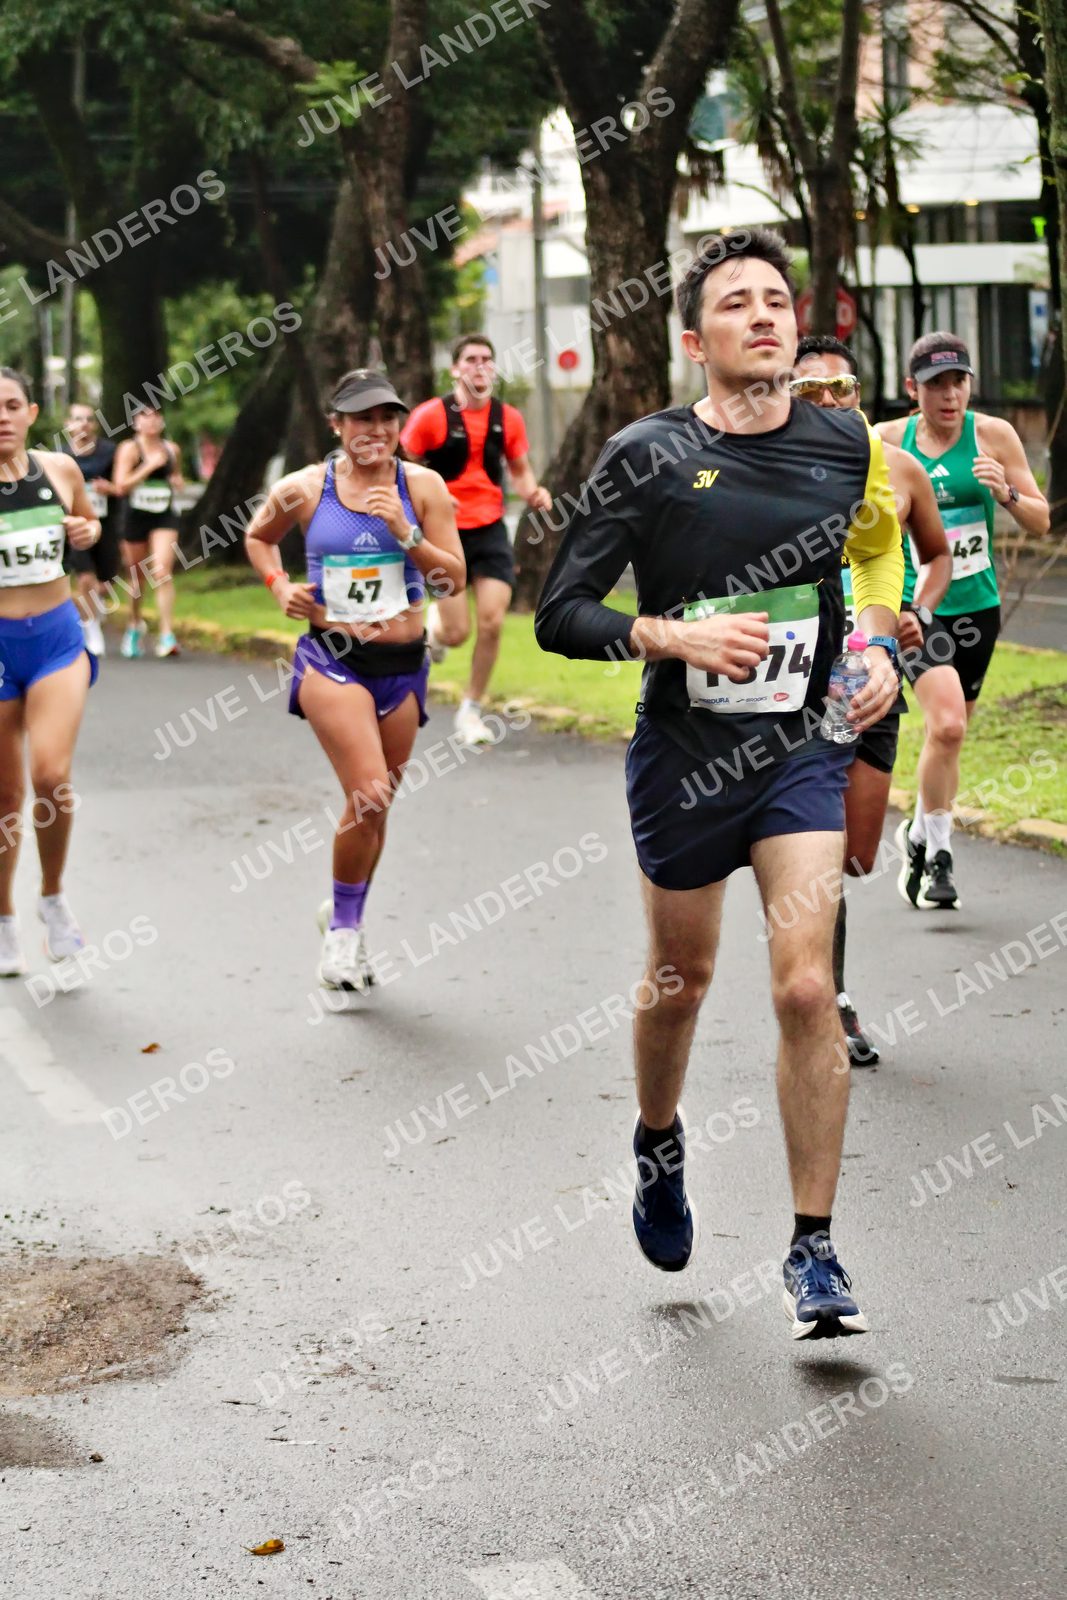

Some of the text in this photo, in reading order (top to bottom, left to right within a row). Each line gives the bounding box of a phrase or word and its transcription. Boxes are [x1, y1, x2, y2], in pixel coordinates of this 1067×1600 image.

[693, 469, 720, 489] 3V
[0, 540, 60, 568] 1543
[348, 579, 382, 604] 47
